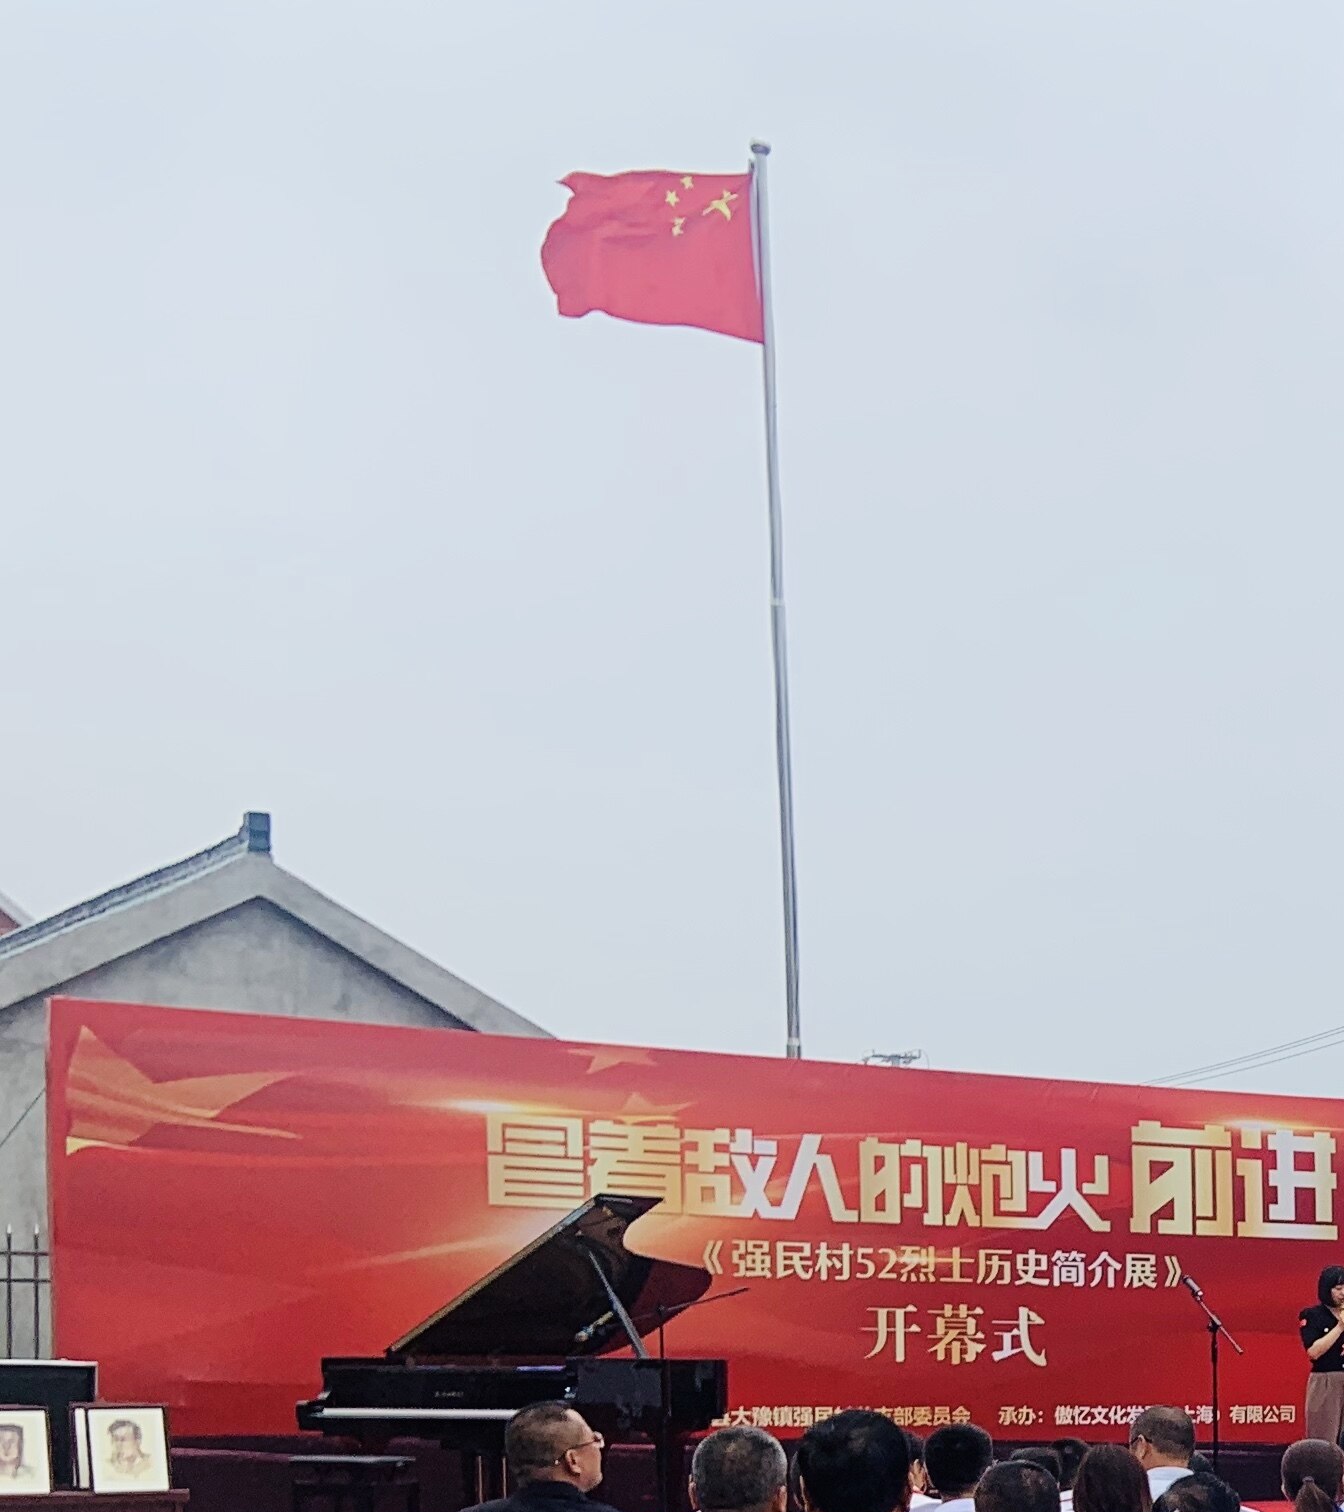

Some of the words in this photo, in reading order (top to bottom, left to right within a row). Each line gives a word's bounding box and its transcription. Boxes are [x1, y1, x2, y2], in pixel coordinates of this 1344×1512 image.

[702, 1240, 1182, 1289] 《强民村52烈士历史简介展》
[860, 1303, 1048, 1368] 开幕式
